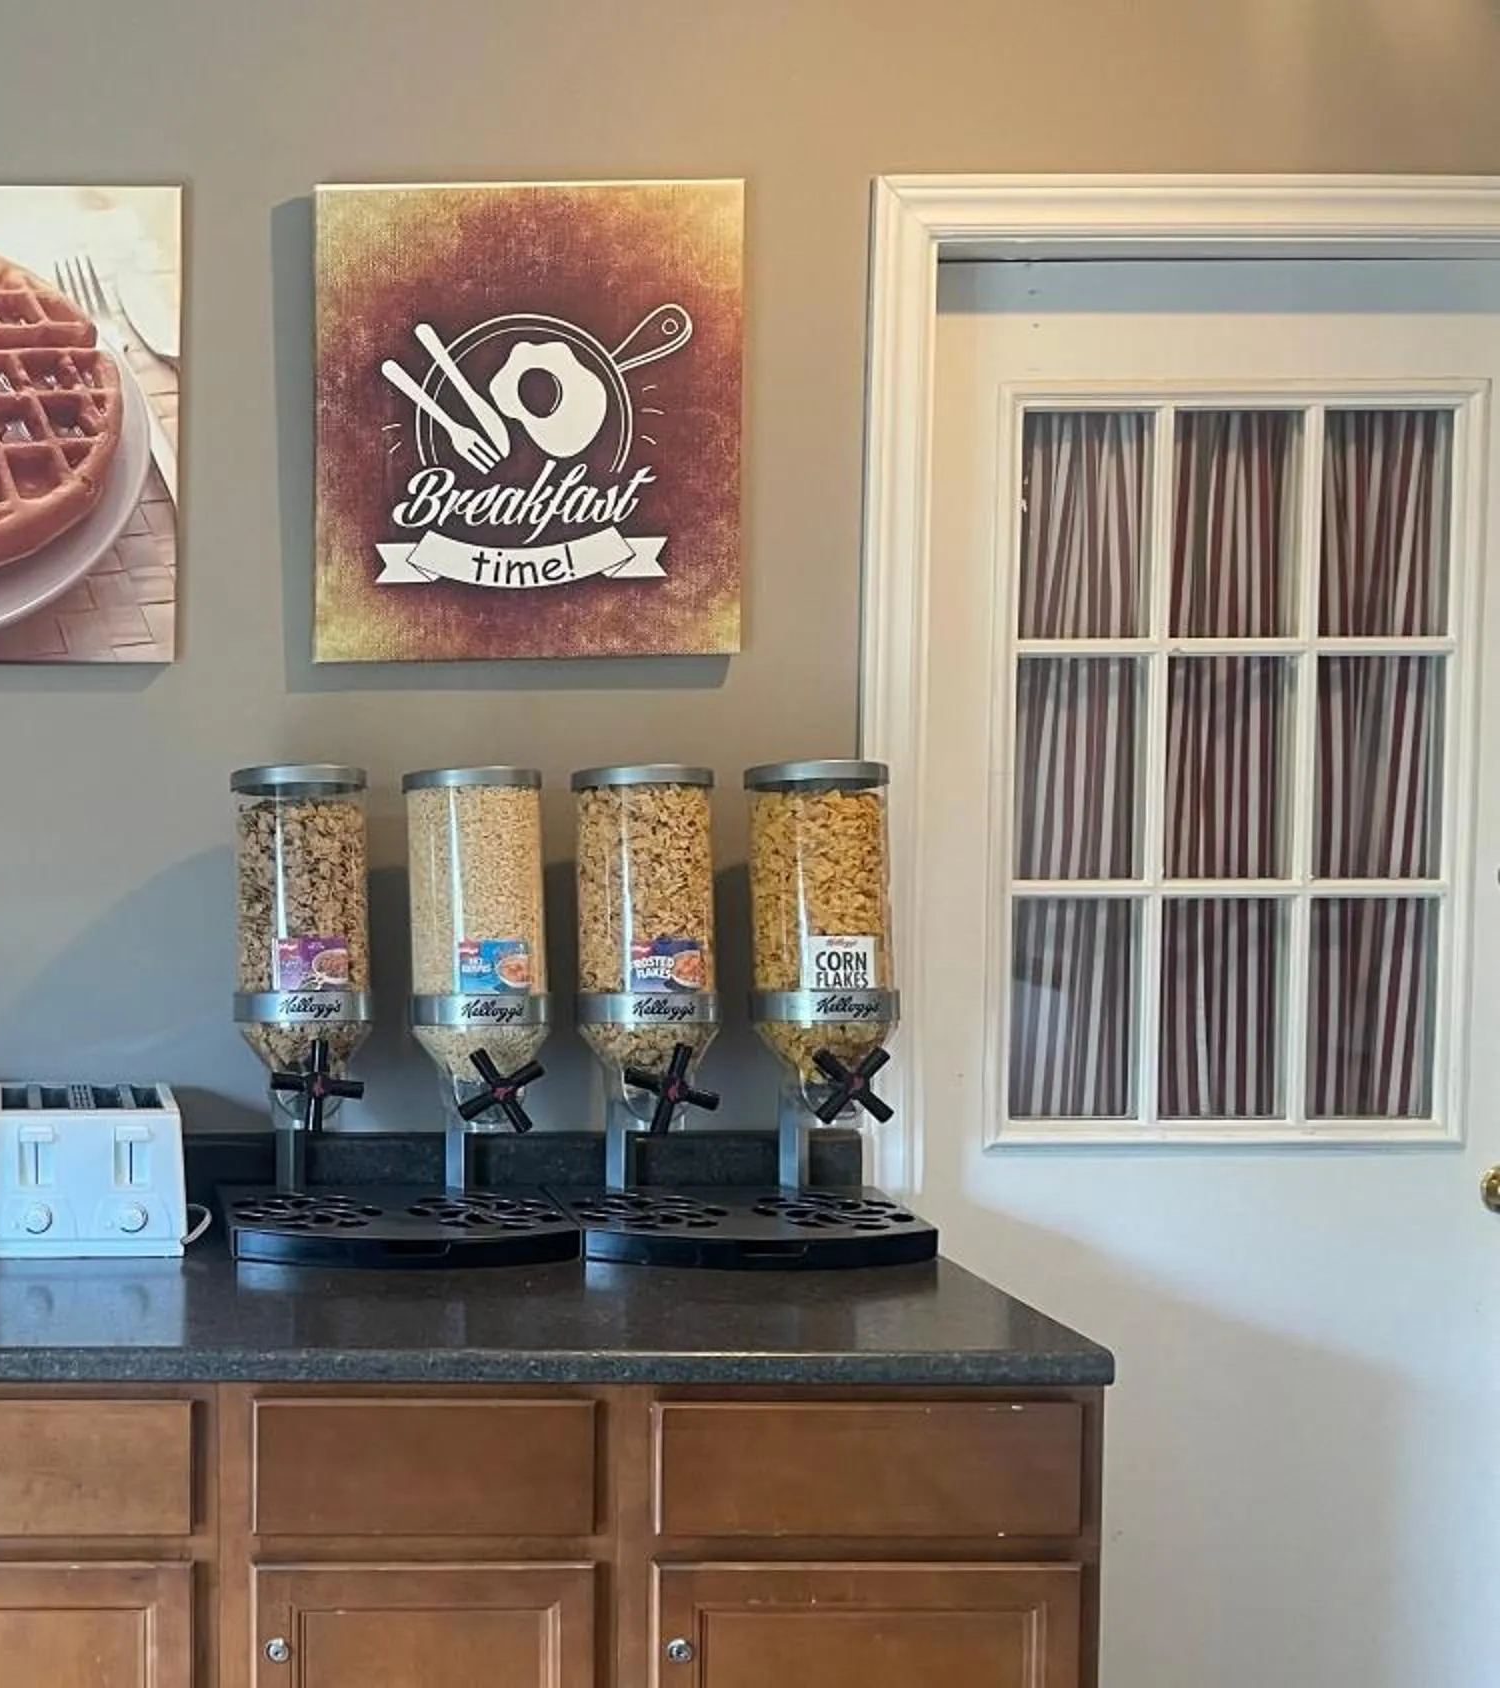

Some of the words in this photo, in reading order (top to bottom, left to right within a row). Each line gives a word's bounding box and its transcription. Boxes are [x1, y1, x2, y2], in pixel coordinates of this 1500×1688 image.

[392, 459, 657, 544] Breakfast
[471, 544, 576, 586] time!
[815, 951, 867, 972] CORN
[816, 971, 869, 989] FLAKES
[279, 995, 341, 1018] Kellogg's
[461, 999, 524, 1022] Kellogg's
[632, 997, 696, 1020] Kellogg's
[815, 994, 879, 1018] Kellogg's
